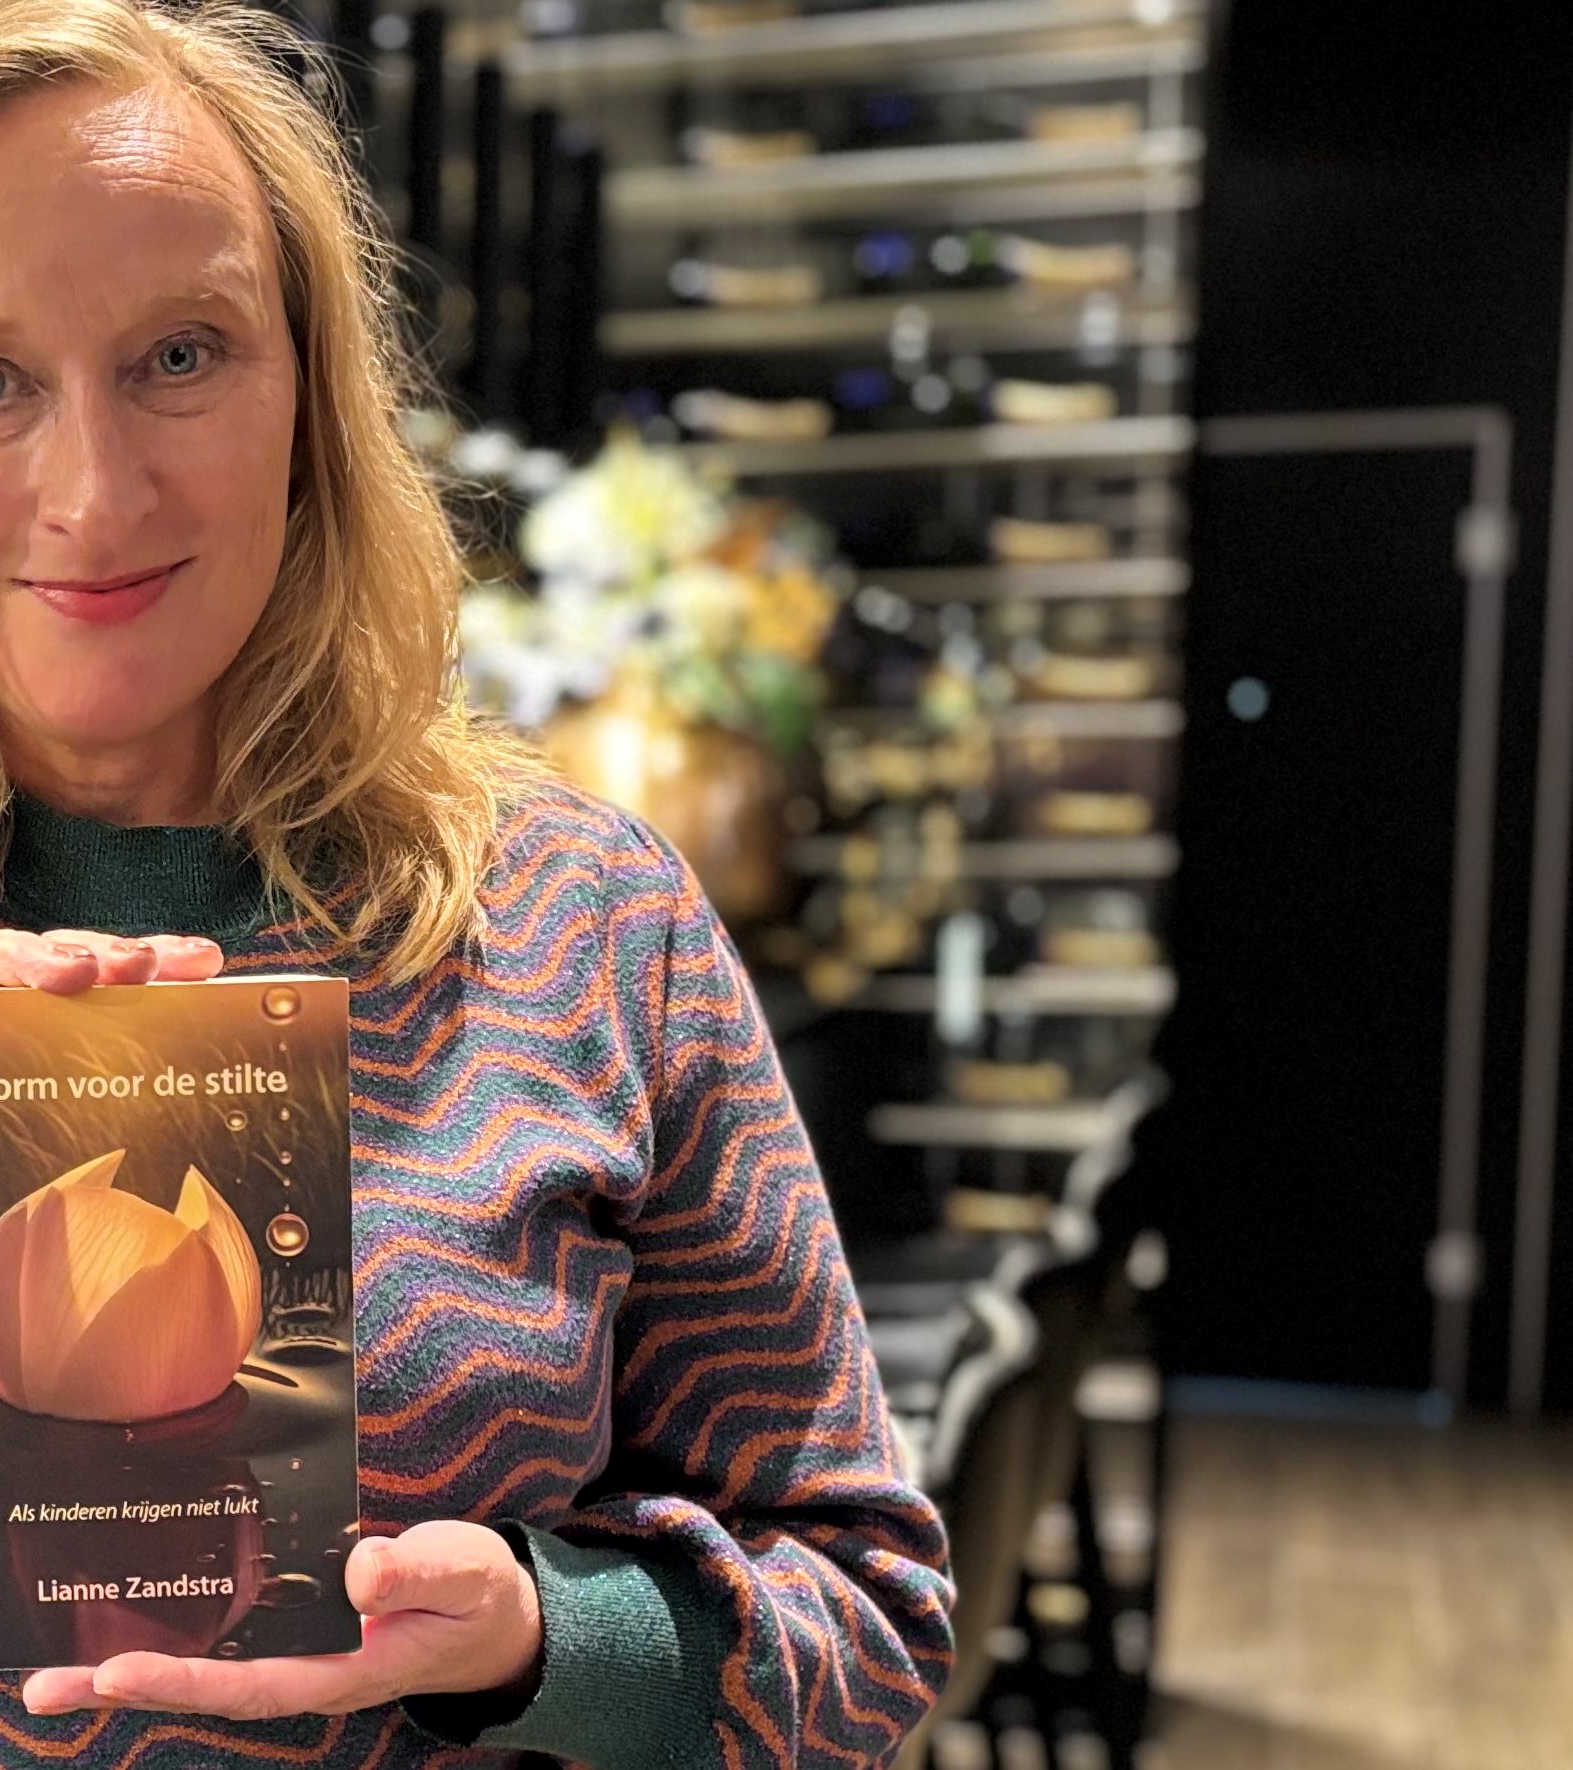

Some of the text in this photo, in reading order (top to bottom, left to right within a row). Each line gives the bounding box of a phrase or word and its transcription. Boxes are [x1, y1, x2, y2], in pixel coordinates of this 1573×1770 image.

[67, 1074, 145, 1098] voor
[153, 1066, 196, 1096] de
[204, 1063, 288, 1095] stilte
[8, 1496, 259, 1523] Als kinderen krijgen niet lukt
[37, 1574, 234, 1602] Lianne Zandstra
